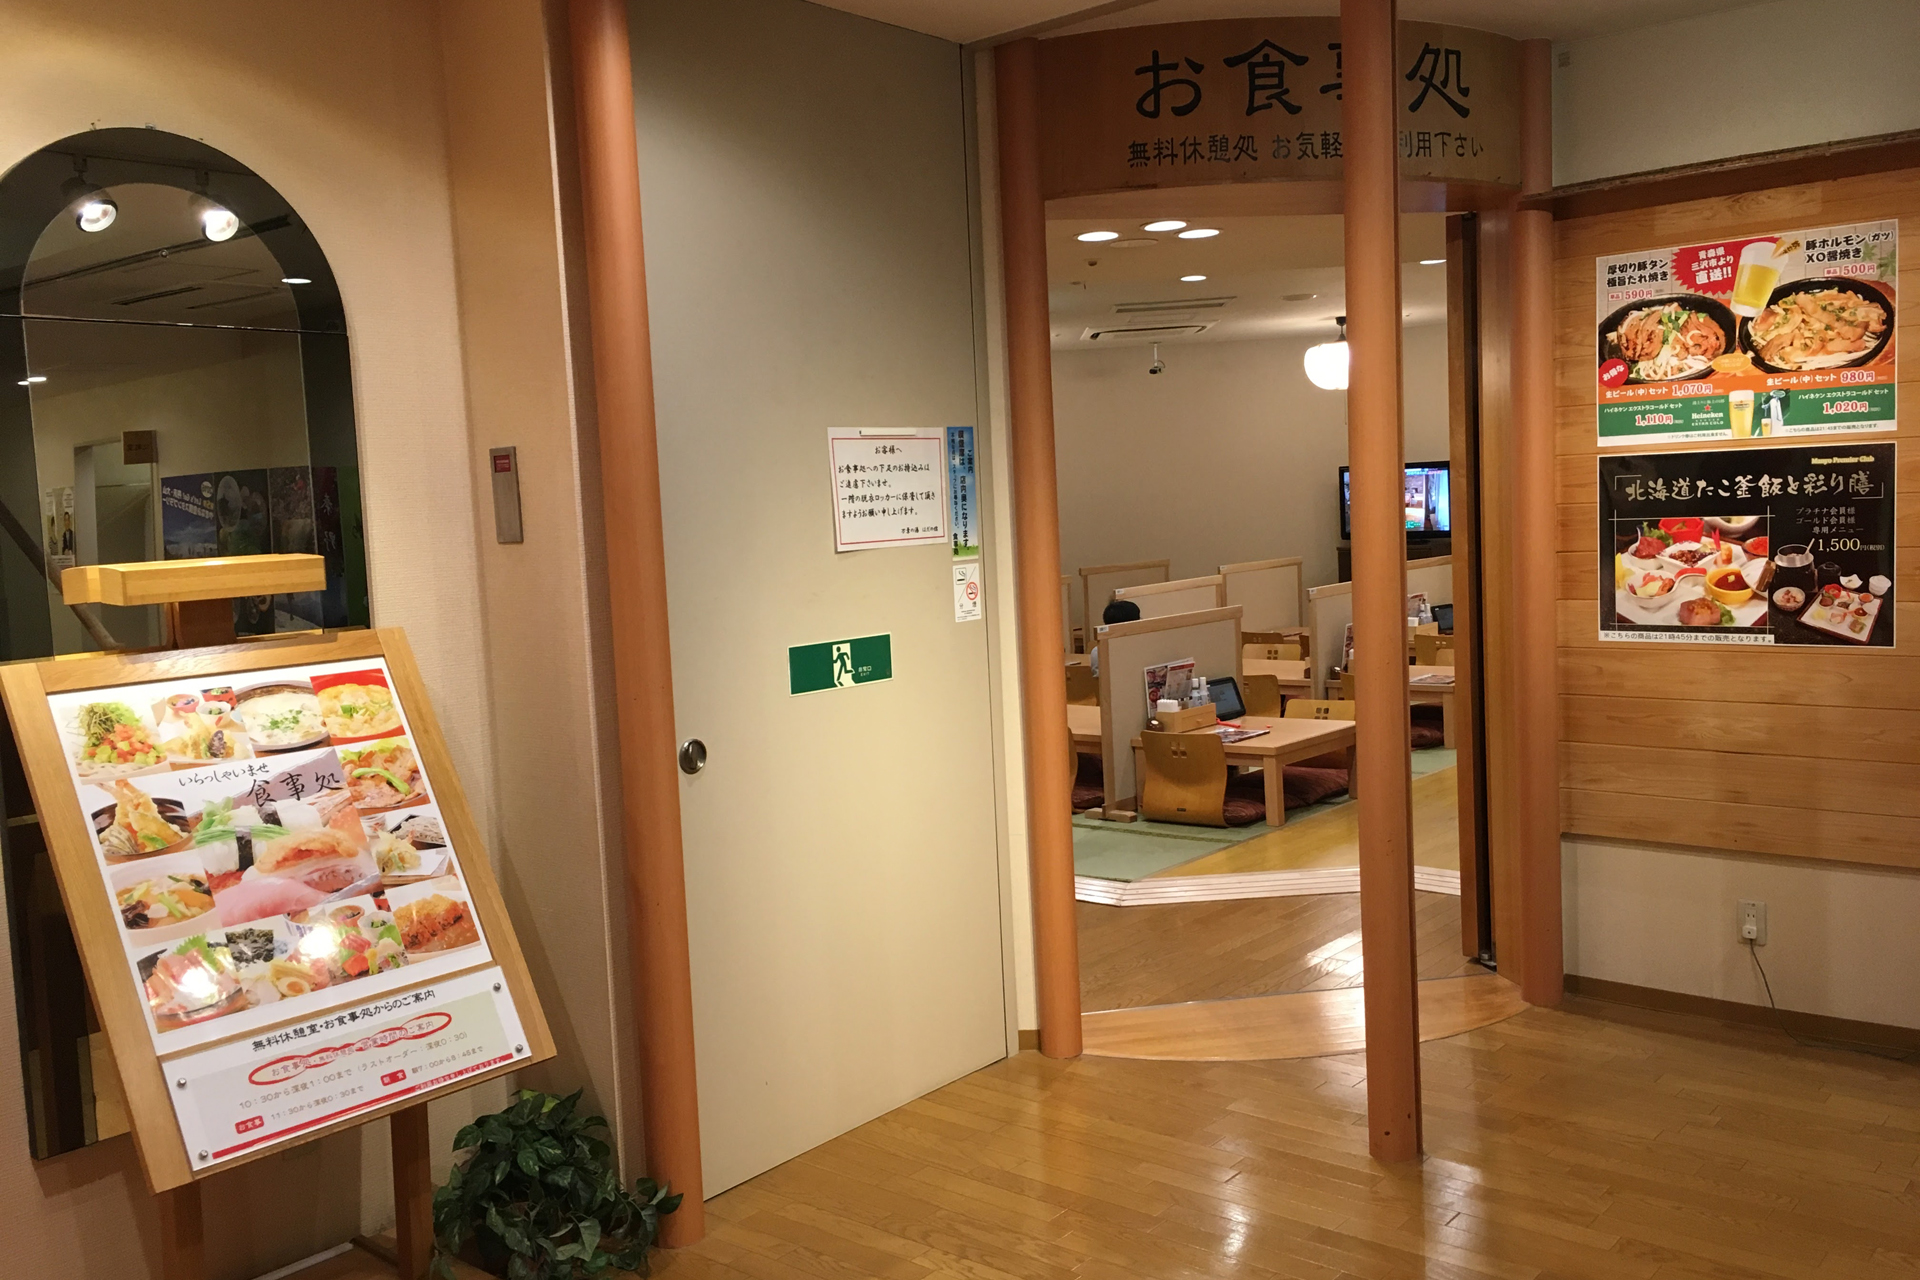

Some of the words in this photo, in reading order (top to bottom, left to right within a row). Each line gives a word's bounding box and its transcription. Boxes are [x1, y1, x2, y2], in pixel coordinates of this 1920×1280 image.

[1127, 133, 1259, 169] 無料休憩処
[1698, 246, 1725, 260] 青森県
[1805, 247, 1863, 264] XO醤焼き
[1607, 259, 1669, 276] 厚切り豚タン
[1691, 255, 1734, 272] 三沢市より
[1843, 263, 1876, 276] 500円
[1607, 270, 1669, 288] 極旨たれ焼き
[1624, 289, 1653, 300] 590円
[1602, 364, 1625, 382] お得な
[1814, 372, 1837, 383] セット
[1840, 370, 1876, 384] 980円
[1648, 385, 1669, 395] セット
[1671, 383, 1713, 396] 1,070円
[1798, 392, 1826, 400] ハイネケン
[1826, 389, 1873, 399] エクストラコールド
[1603, 405, 1628, 414] ハイネケン
[1823, 400, 1868, 414] 1,020円
[1635, 412, 1674, 426] 1,110円
[1691, 411, 1724, 419] Heineken
[874, 444, 903, 455] お客様へ
[1796, 506, 1856, 516] プラチナ会員様
[1795, 516, 1856, 525] ゴールド会員様
[1812, 526, 1864, 535] 専用メニュー
[178, 762, 271, 787] いらっしゃいませ
[247, 772, 344, 808] 食事処
[251, 989, 436, 1052] 無料休憩室・お食事処からのご案内
[237, 1118, 263, 1133] お食事
